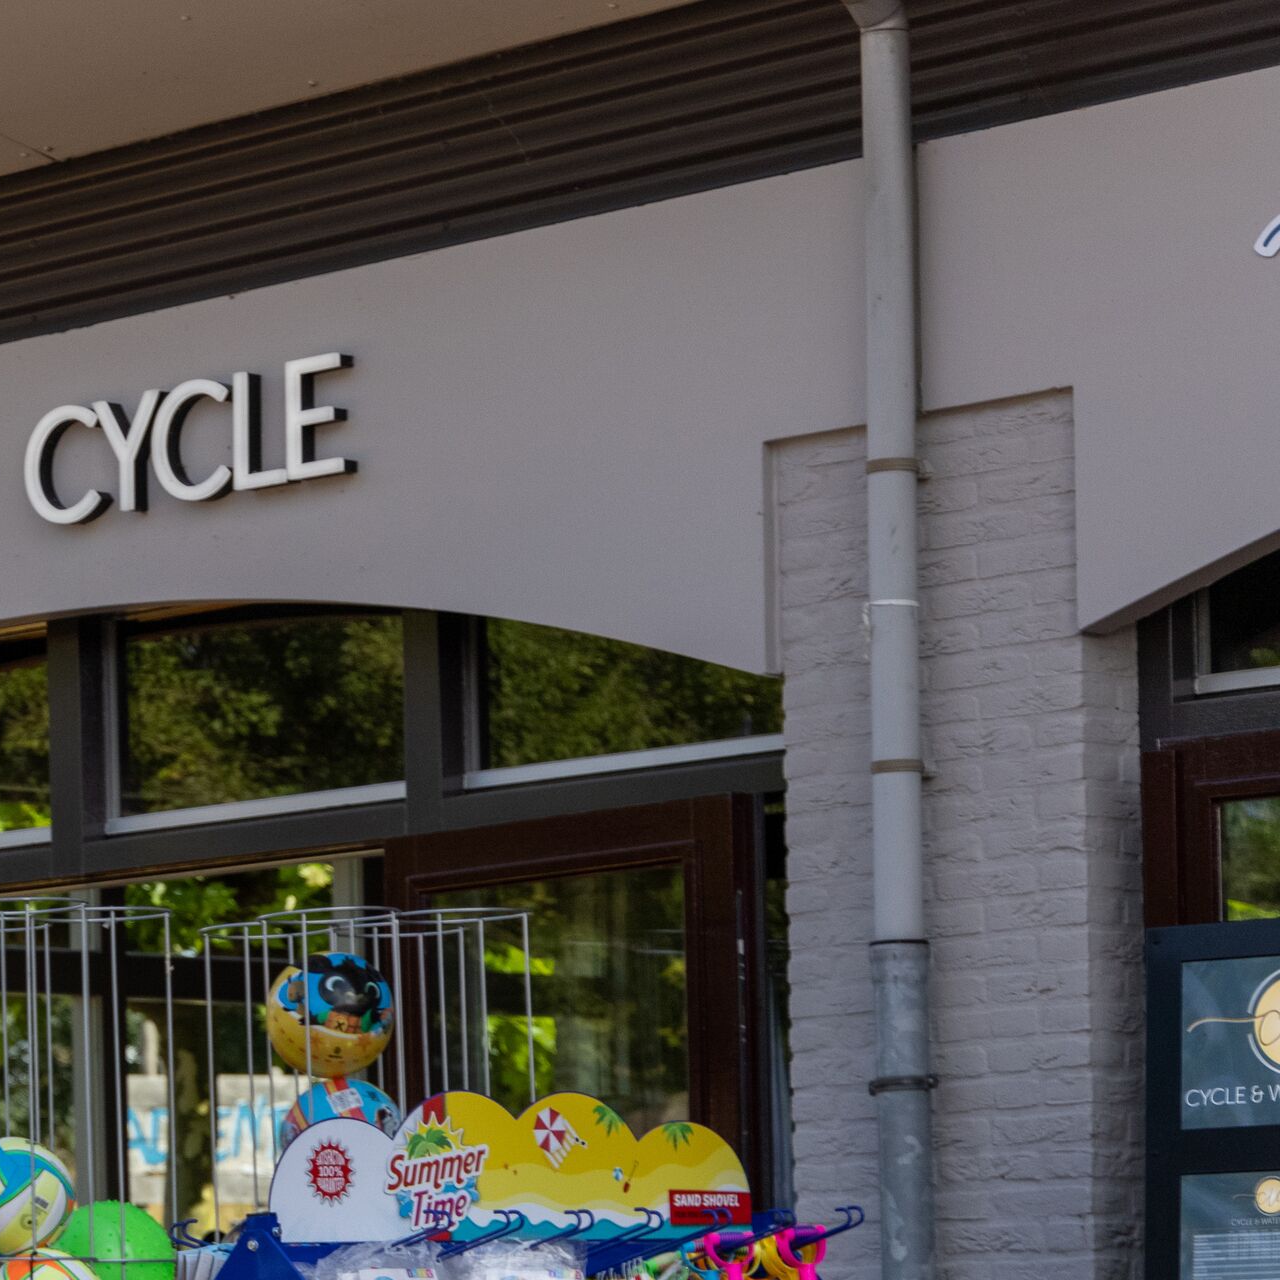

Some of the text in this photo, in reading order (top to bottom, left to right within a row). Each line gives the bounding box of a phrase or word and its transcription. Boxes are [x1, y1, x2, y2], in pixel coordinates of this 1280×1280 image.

[24, 352, 357, 525] CYCLE
[1185, 1086, 1247, 1108] CYCLE
[386, 1148, 487, 1192] Summer
[412, 1188, 468, 1228] Time
[672, 1193, 740, 1208] SAND SHOVEL
